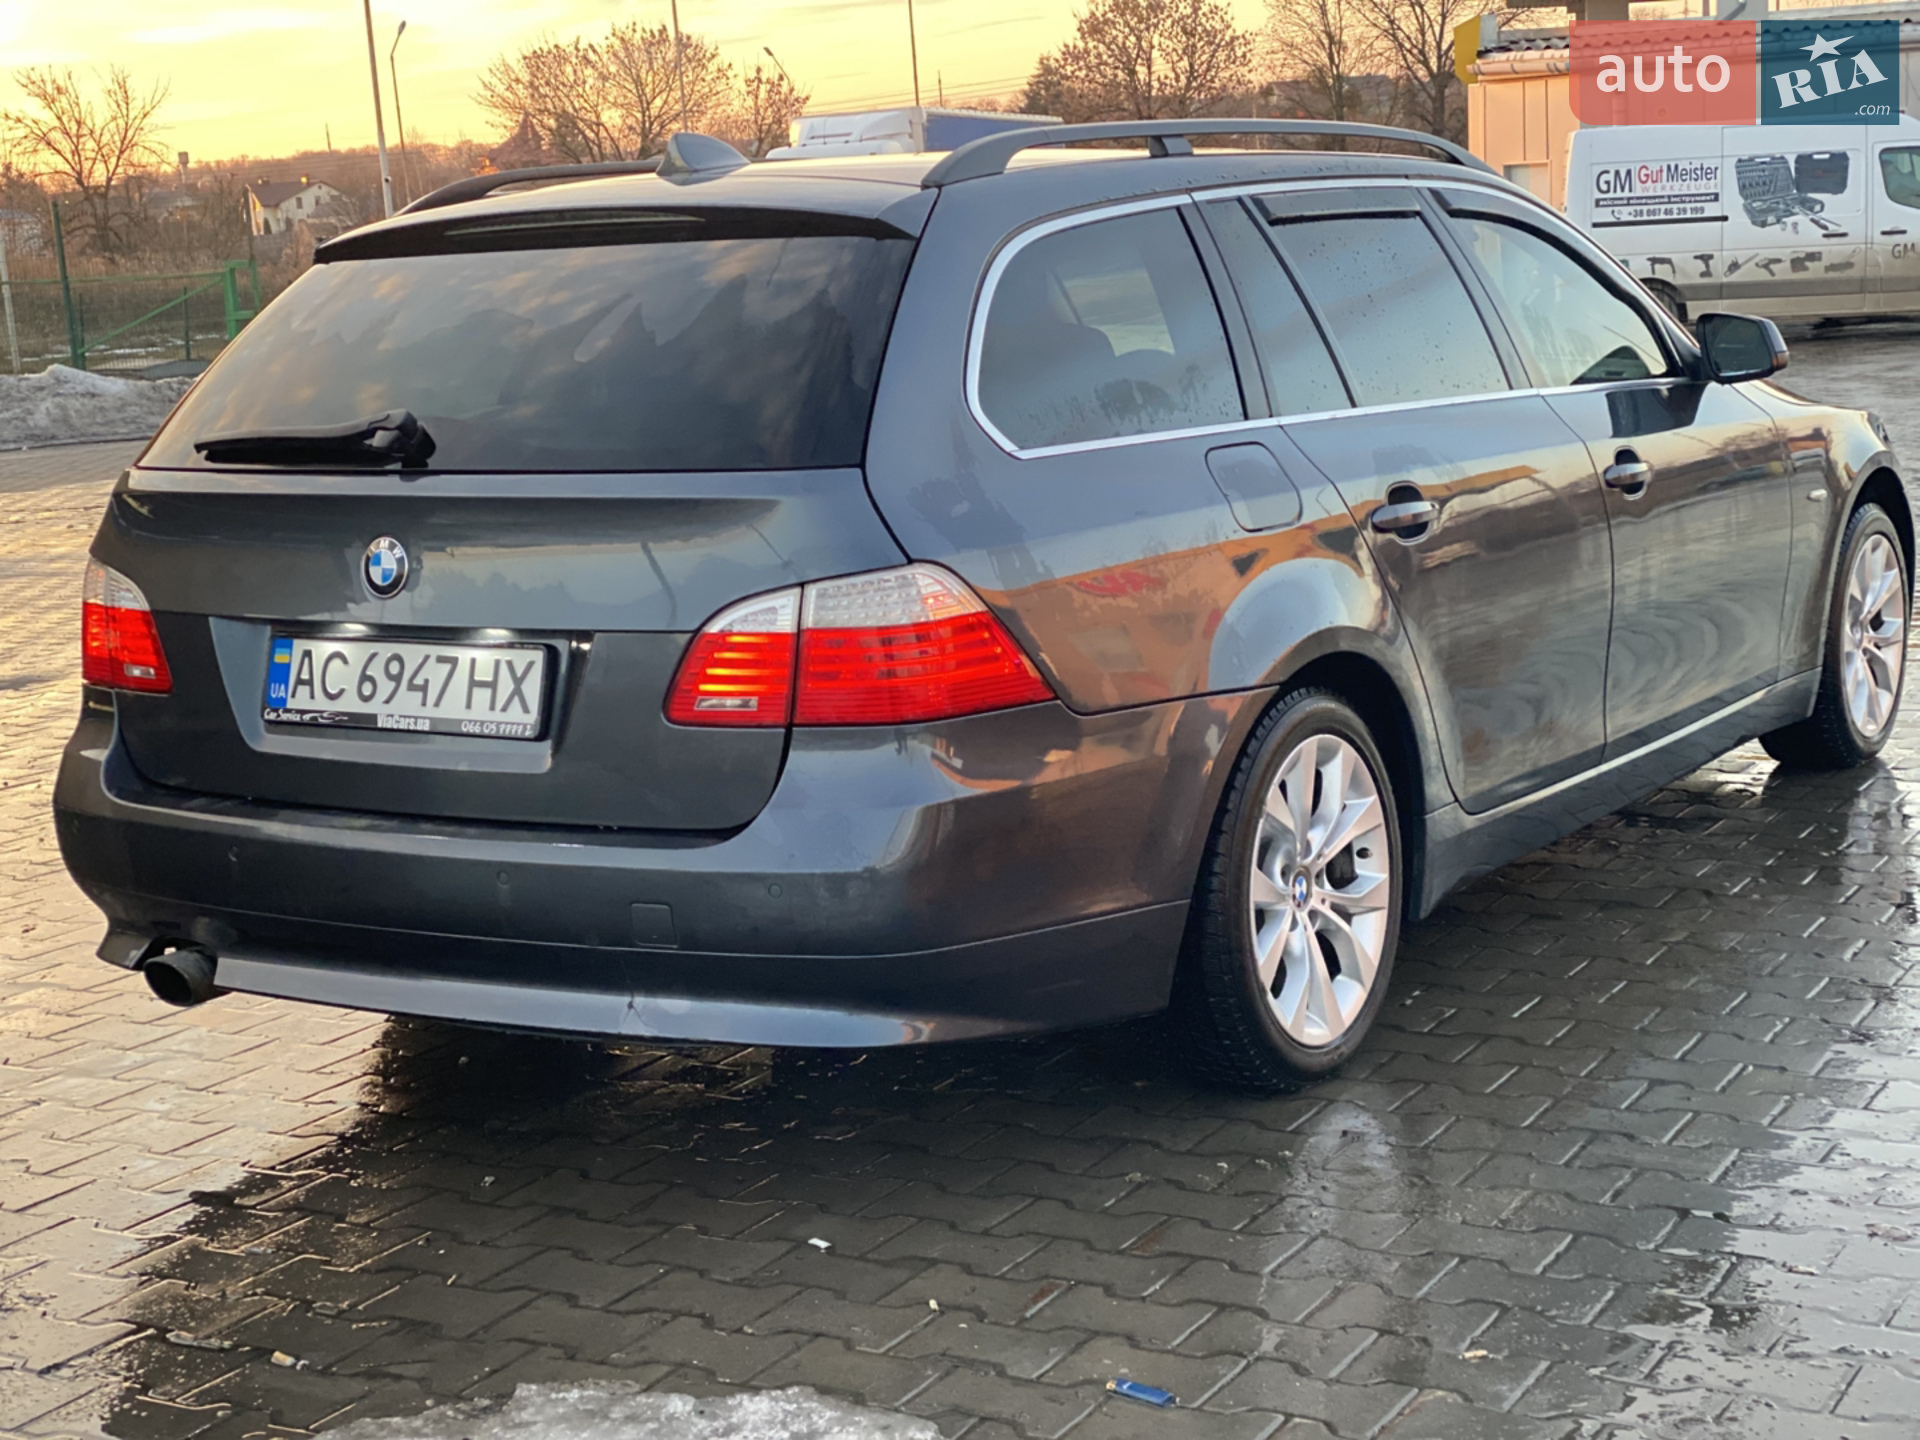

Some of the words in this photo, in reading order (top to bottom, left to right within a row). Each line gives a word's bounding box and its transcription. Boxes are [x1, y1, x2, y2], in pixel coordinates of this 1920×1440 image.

[1595, 168, 1633, 194] GM
[1637, 164, 1664, 185] Gut
[1666, 161, 1719, 183] Meister
[1640, 181, 1719, 193] WERKZEUGE
[270, 683, 286, 698] UA
[290, 649, 349, 701] AC
[356, 651, 459, 708] 6947
[465, 657, 536, 715] HX
[376, 713, 430, 731] ViaCars.ua
